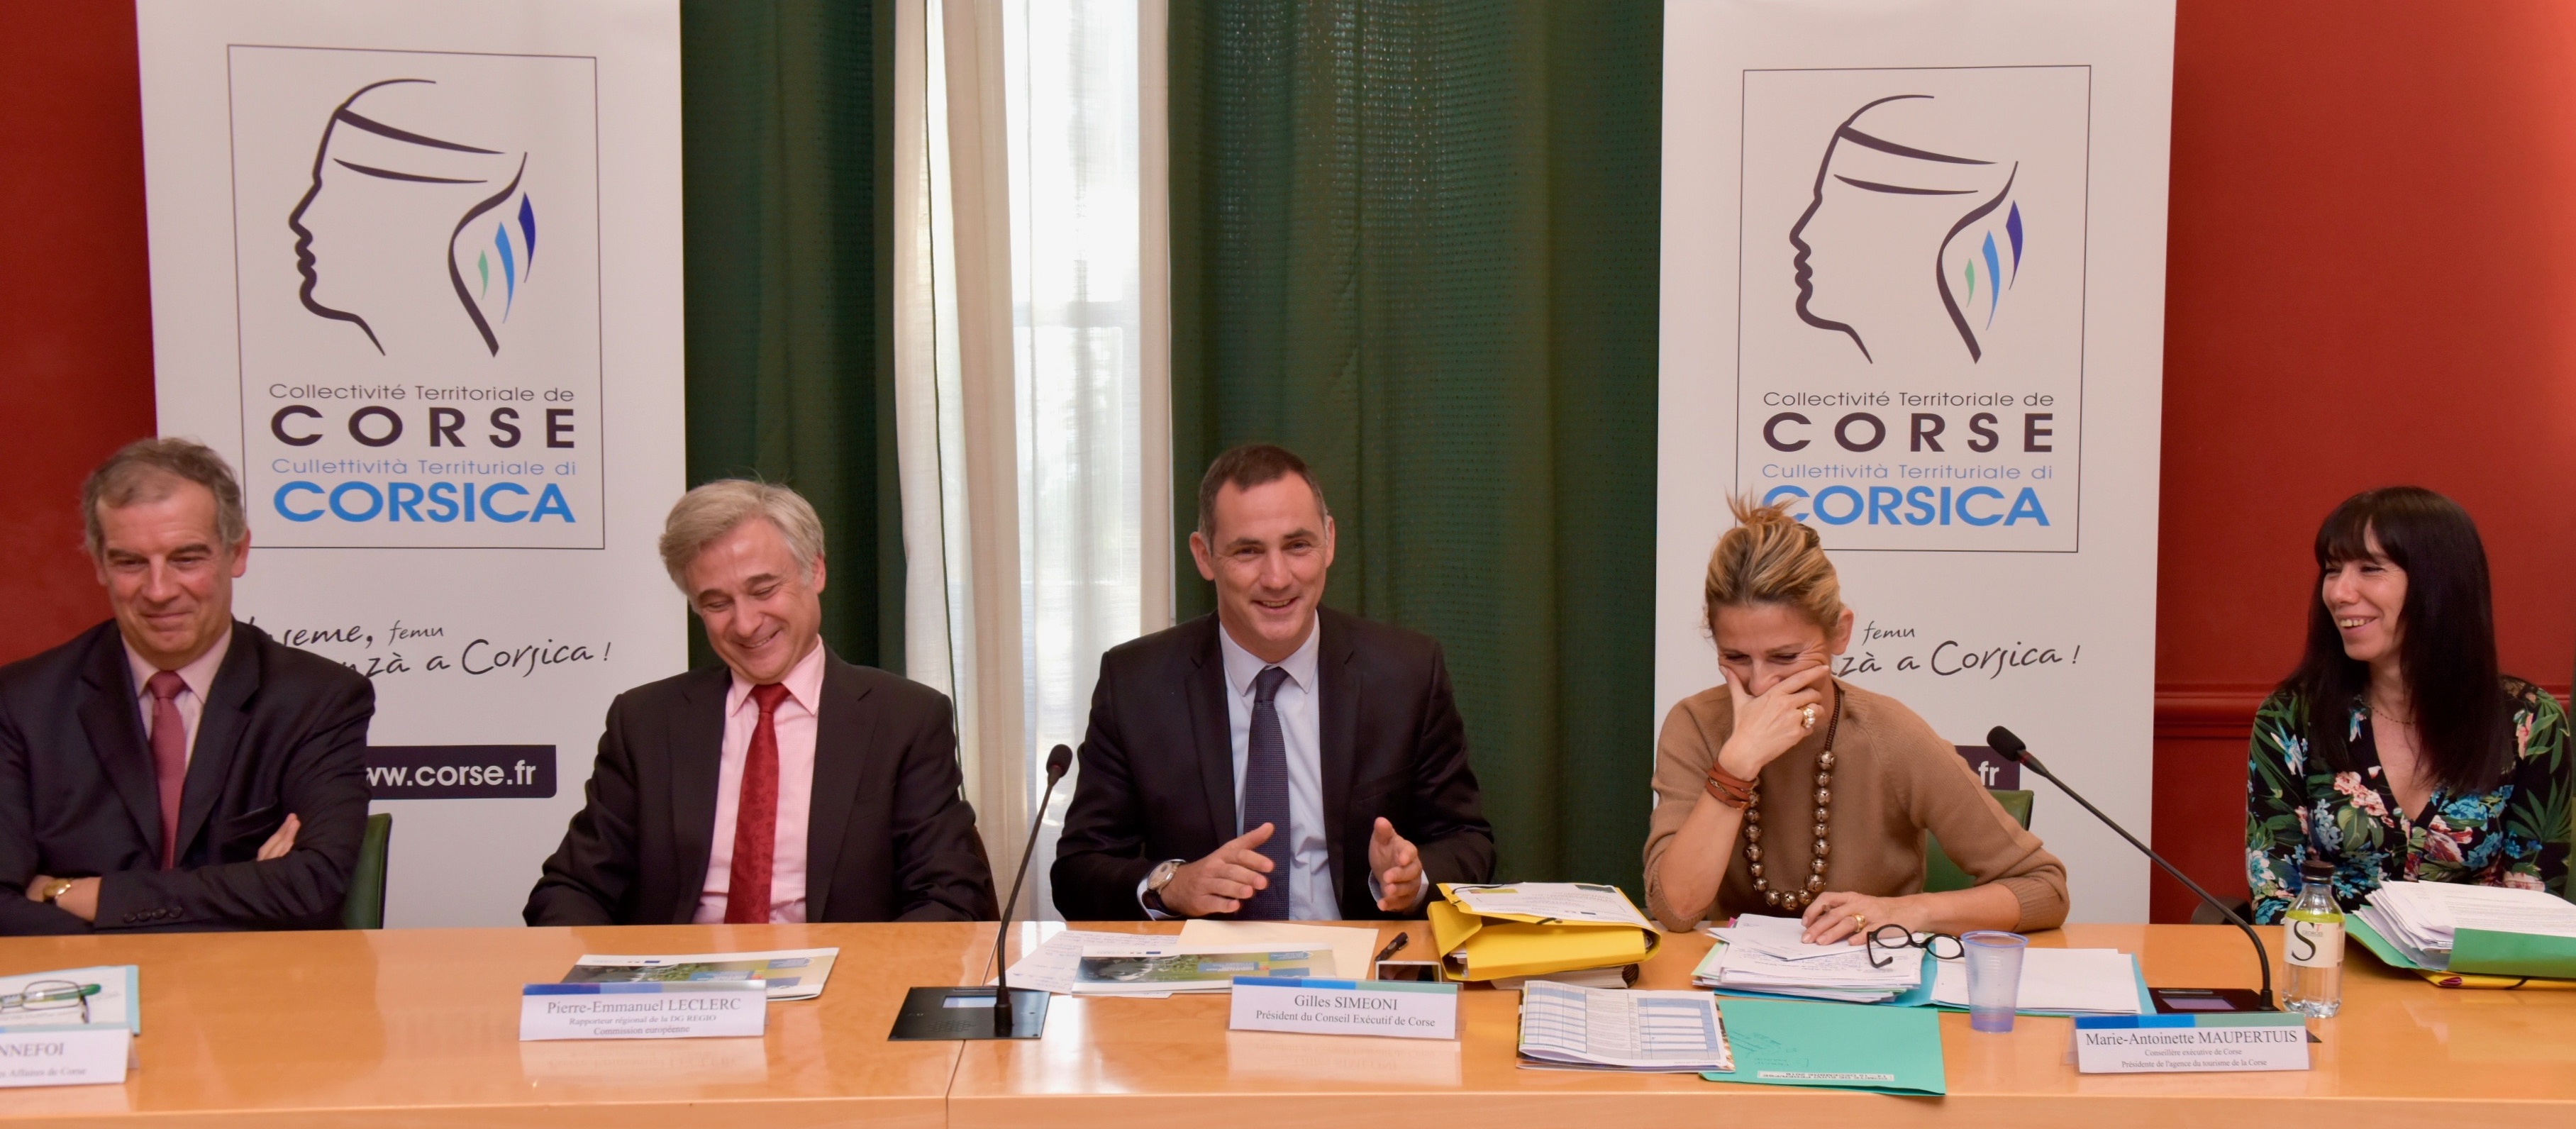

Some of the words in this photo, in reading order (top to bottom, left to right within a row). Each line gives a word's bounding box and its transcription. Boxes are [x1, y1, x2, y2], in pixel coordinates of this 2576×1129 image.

[270, 384, 406, 400] Collectivité
[415, 386, 534, 401] Territoriale
[544, 388, 574, 402] de
[1763, 391, 1890, 406] Collectivité
[1899, 392, 2014, 406] Territoriale
[2023, 392, 2054, 406] de
[271, 404, 574, 448] CORSE
[1763, 411, 2053, 453] CORSE
[272, 459, 407, 474] Cullettività
[418, 460, 545, 475] Territuriale
[555, 462, 576, 475] di
[1762, 464, 1888, 479] Cullettività
[1899, 465, 2021, 479] Territuriale
[2031, 465, 2053, 479] di
[273, 481, 576, 523] CORSICA
[1762, 485, 2051, 527] CORSICA
[389, 620, 444, 646] femu
[1862, 621, 1915, 646] femu
[426, 655, 450, 672] a
[462, 638, 594, 678] Corsica
[604, 642, 611, 661] !
[1897, 655, 1921, 671] a
[1931, 640, 2063, 680] Corsica
[2071, 644, 2081, 664] !
[366, 760, 536, 787] ww.corse.fr
[547, 1000, 663, 1014] Pierre-Emmanuel
[668, 998, 741, 1011] LECLERC
[1294, 994, 1331, 1008] Gilles
[1335, 996, 1397, 1011] SIMEONI
[570, 1017, 613, 1026] Rapporteur
[615, 1016, 647, 1025] régional
[1256, 1010, 1298, 1021] Président
[1301, 1011, 1312, 1021] du
[1315, 1012, 1350, 1023] Conseil
[1353, 1014, 1393, 1025] Exécutif
[1394, 1016, 1406, 1025] de
[1408, 1016, 1436, 1027] Corse
[594, 1025, 643, 1035] Commission
[645, 1025, 690, 1035] européenne
[2086, 1032, 2194, 1045] Marie-Antoinette
[2199, 1030, 2297, 1044] MAUPERTUIS
[0, 1042, 65, 1057] NNEFOI
[2121, 1060, 2155, 1068] Présidente
[2165, 1060, 2191, 1069] l'agence
[2202, 1059, 2230, 1067] tourisme
